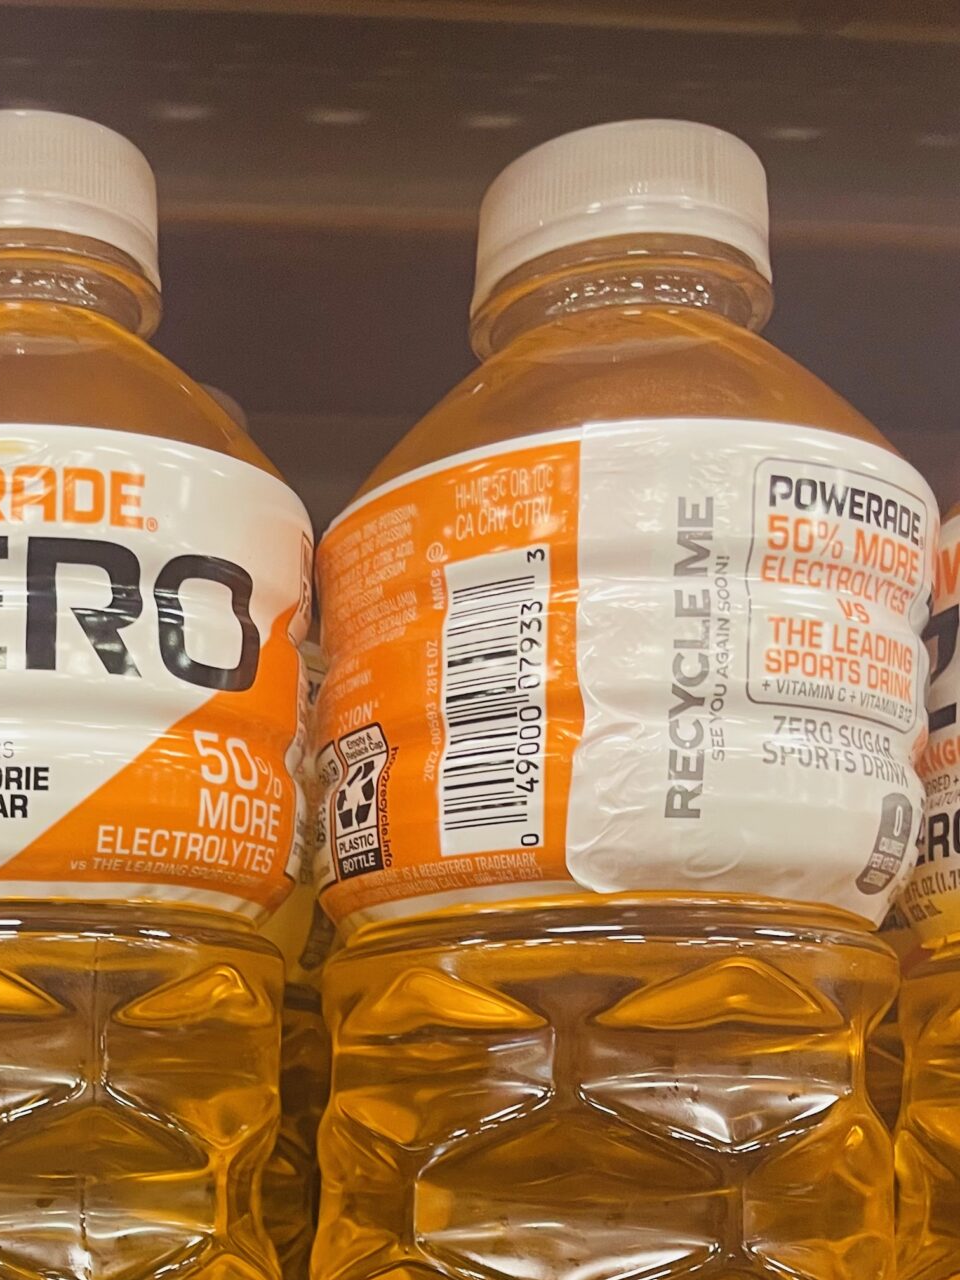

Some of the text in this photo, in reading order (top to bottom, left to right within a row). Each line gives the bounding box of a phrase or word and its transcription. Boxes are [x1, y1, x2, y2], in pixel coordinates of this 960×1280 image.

[455, 496, 553, 541] CA CTRV
[767, 513, 920, 587] 50% MORE
[836, 597, 871, 625] VS
[663, 496, 715, 819] RECYCLE ME
[709, 554, 731, 762] SEE YOU AGAIN SOON!
[767, 616, 913, 675] THE LEADING
[515, 600, 544, 794] 49000 07933
[764, 648, 913, 705] SPORTS DRINK
[776, 680, 898, 717] VITAMIN VITAMIN
[345, 734, 367, 753] Empty
[772, 714, 894, 761] ZERO SUGAR
[193, 729, 283, 800] 50%
[761, 740, 910, 789] SPORTS DRINK
[197, 787, 282, 843] MORE
[91, 857, 189, 878] THE LEADING
[339, 832, 375, 856] PLASTIC
[342, 852, 376, 875] BOTTLE
[419, 852, 537, 877] REGISTERED TRADEMARK
